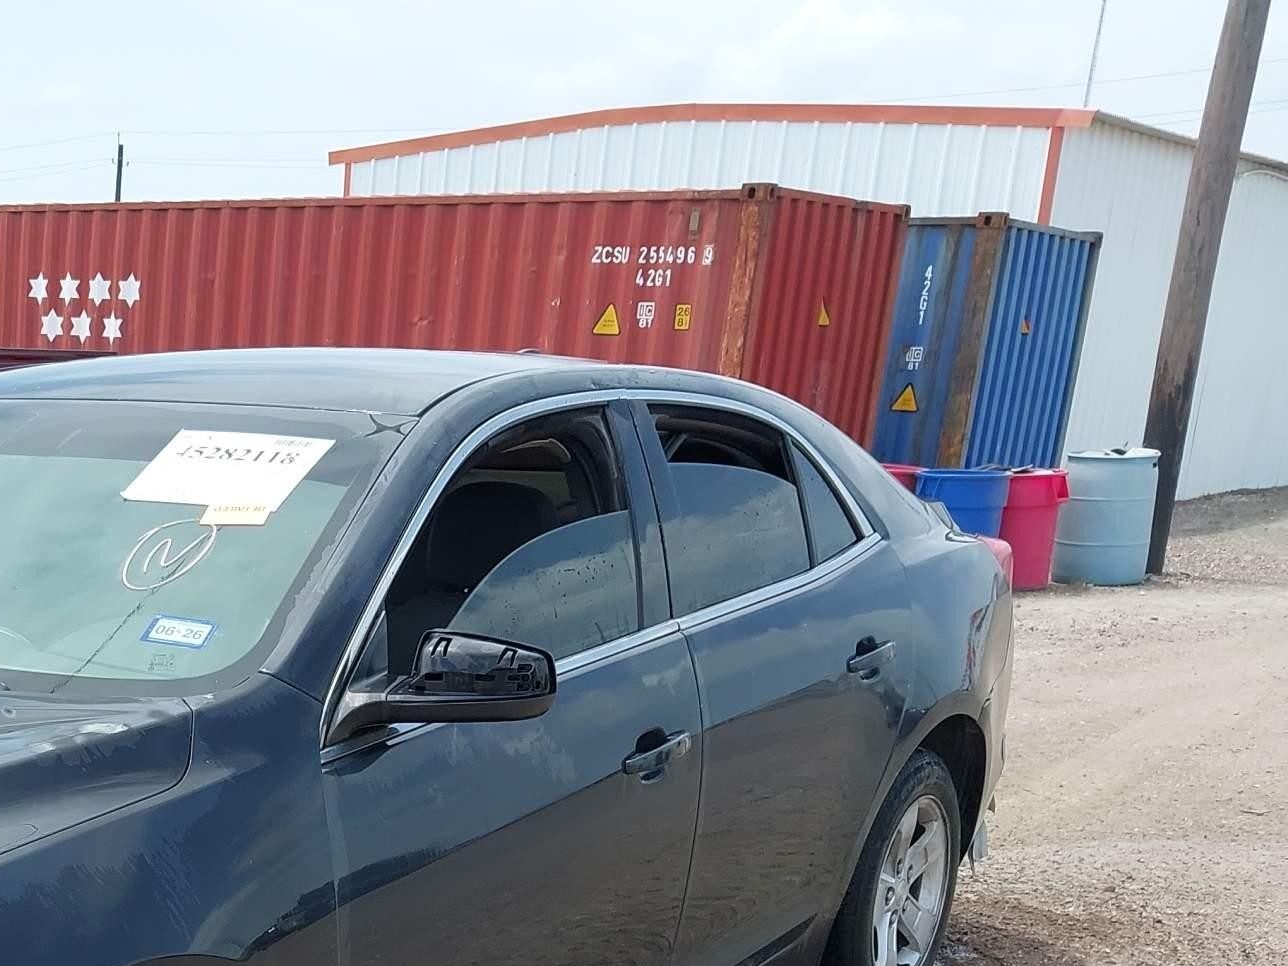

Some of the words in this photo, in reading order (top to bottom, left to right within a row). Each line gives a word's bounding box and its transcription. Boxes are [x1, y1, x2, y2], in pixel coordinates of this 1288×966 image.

[591, 246, 630, 264] ZCSU
[638, 246, 696, 264] 255496
[704, 246, 713, 264] 9
[635, 268, 671, 287] 42G1
[918, 265, 933, 325] 42G1
